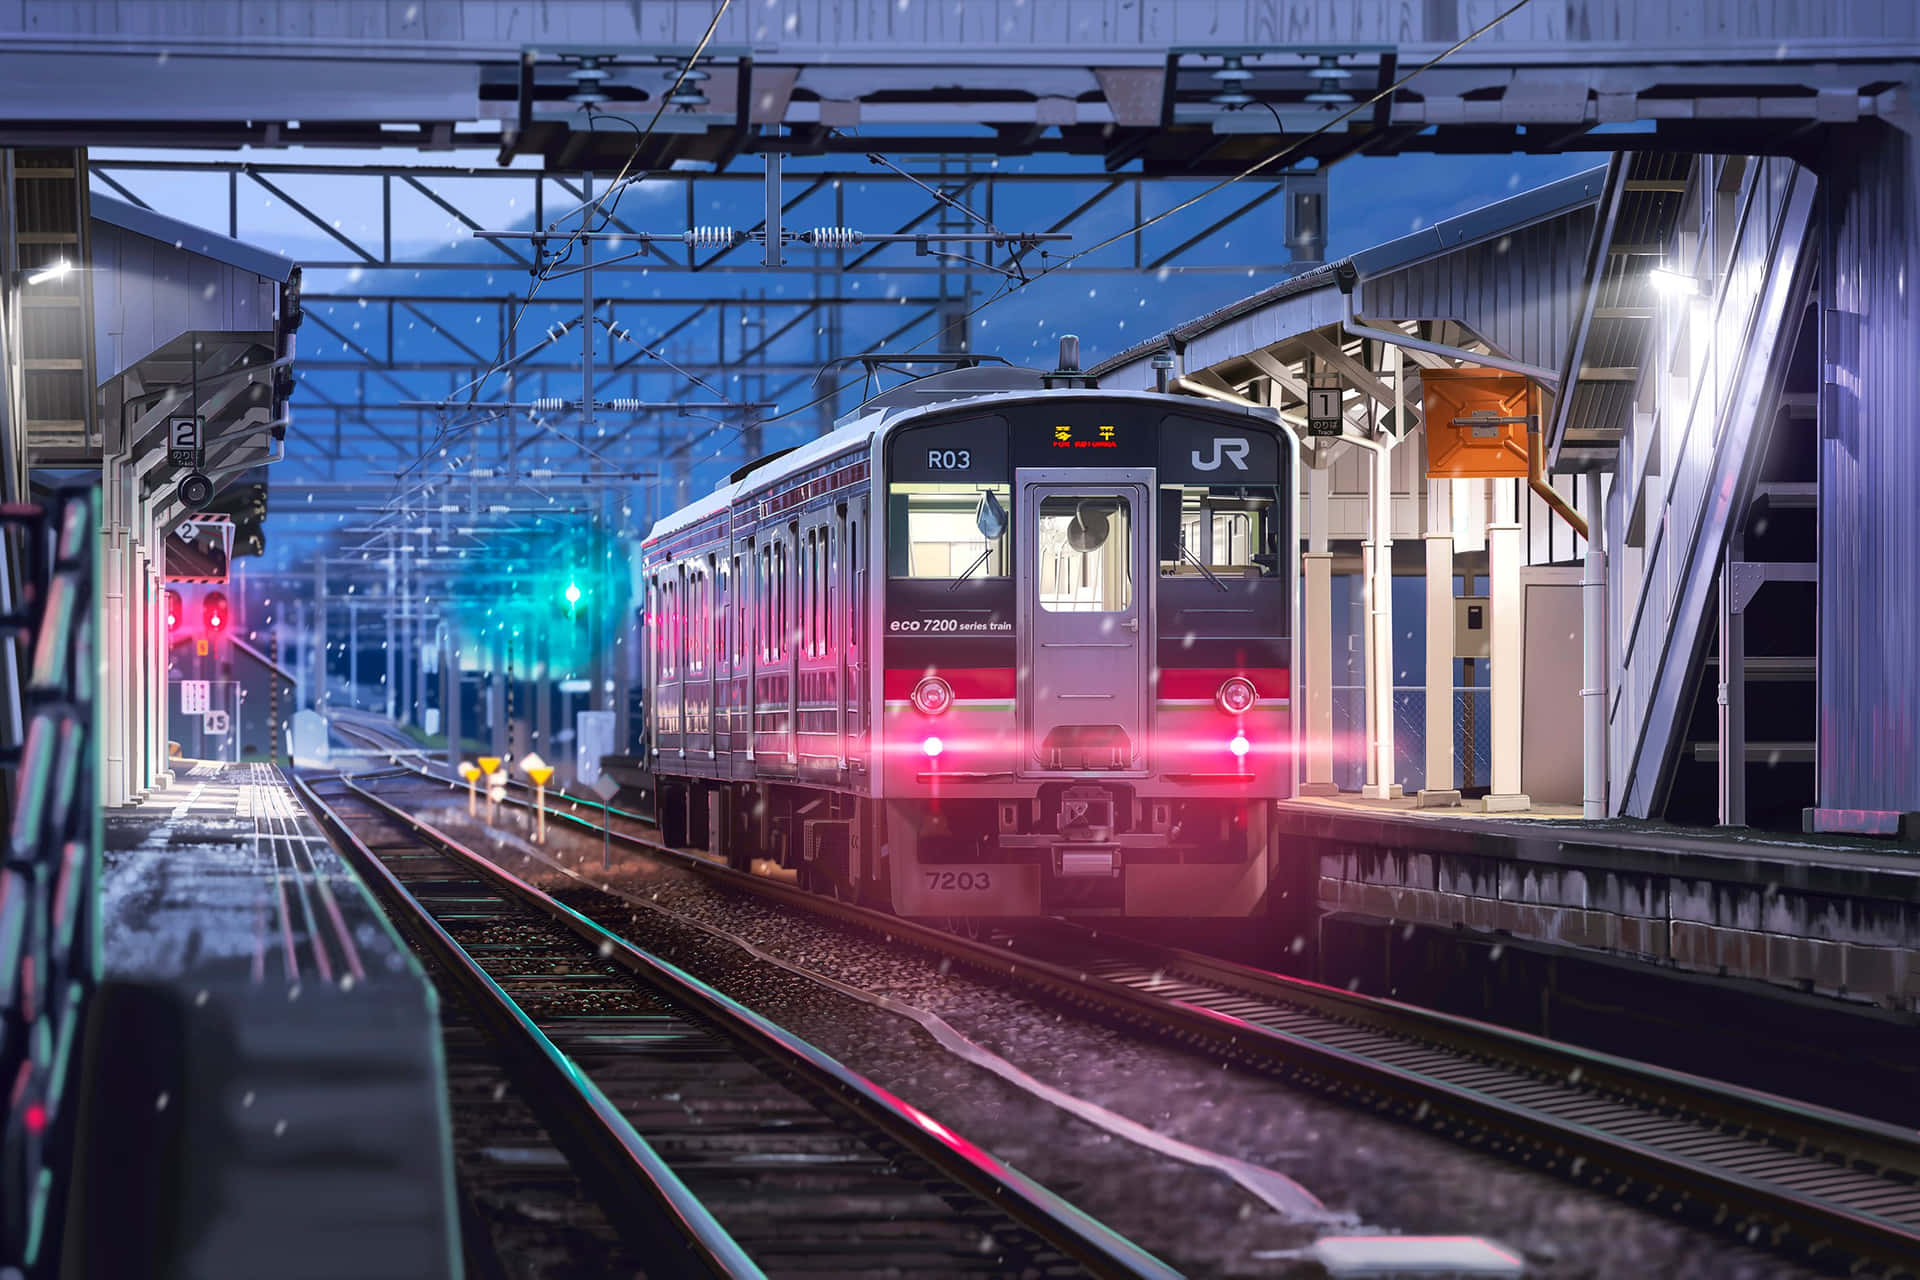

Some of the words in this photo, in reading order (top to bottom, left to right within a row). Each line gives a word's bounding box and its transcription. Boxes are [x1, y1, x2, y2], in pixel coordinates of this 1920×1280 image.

[1319, 394, 1329, 416] 1
[177, 422, 195, 445] 2
[172, 450, 197, 460] のり
[928, 450, 970, 469] R03
[1191, 438, 1250, 471] JR
[182, 523, 193, 539] 2
[890, 620, 920, 631] eco
[923, 619, 958, 631] 7200
[959, 621, 987, 631] series
[989, 621, 1012, 631] train
[926, 872, 990, 890] 7203
